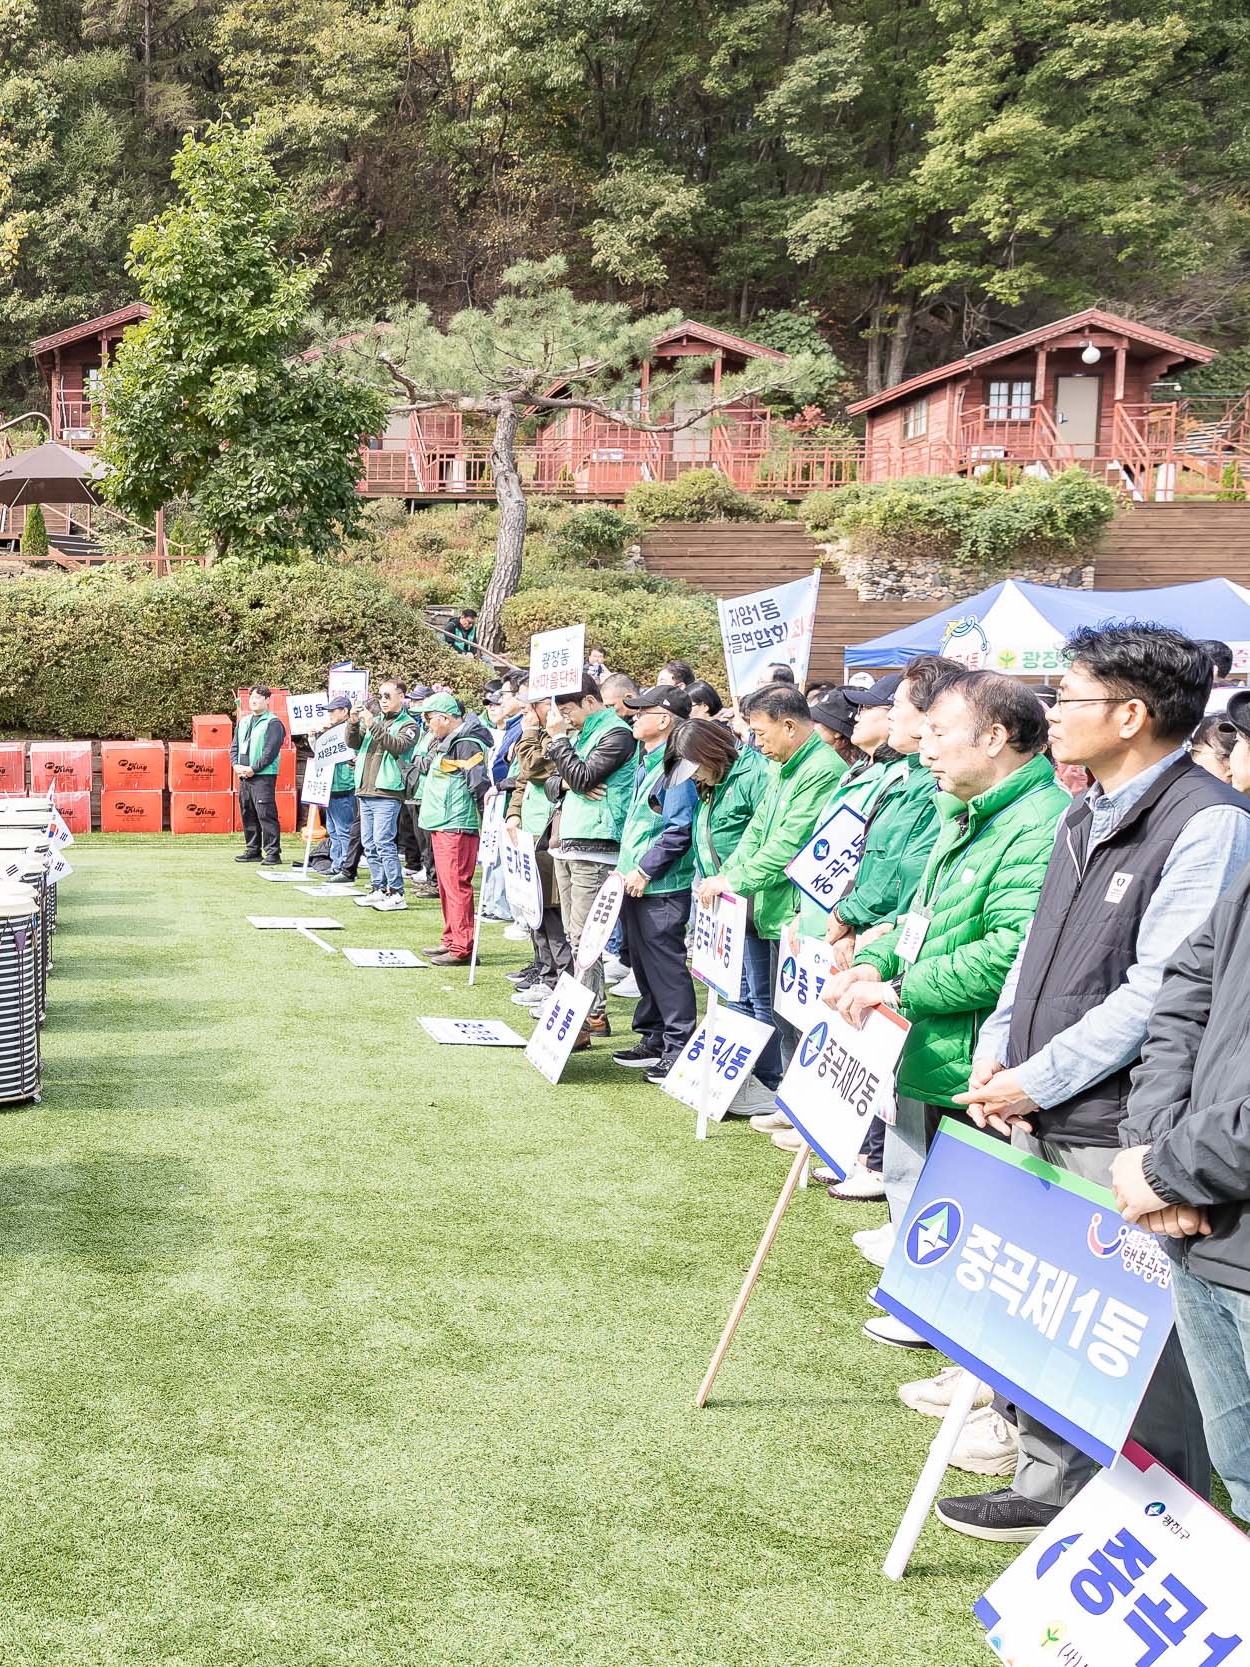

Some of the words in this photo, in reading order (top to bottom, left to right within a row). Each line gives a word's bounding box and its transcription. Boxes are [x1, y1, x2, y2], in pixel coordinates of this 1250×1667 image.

[729, 621, 789, 655] 을연합회
[541, 648, 570, 670] 광장동
[292, 703, 325, 719] 화양동
[317, 741, 347, 761] 자양2동
[546, 999, 575, 1042] 능동
[817, 1037, 880, 1117] 중곡제2동
[954, 1223, 1149, 1378] 중곡제1동
[1162, 1514, 1191, 1540] 광진구
[1058, 1642, 1089, 1667] (사)
